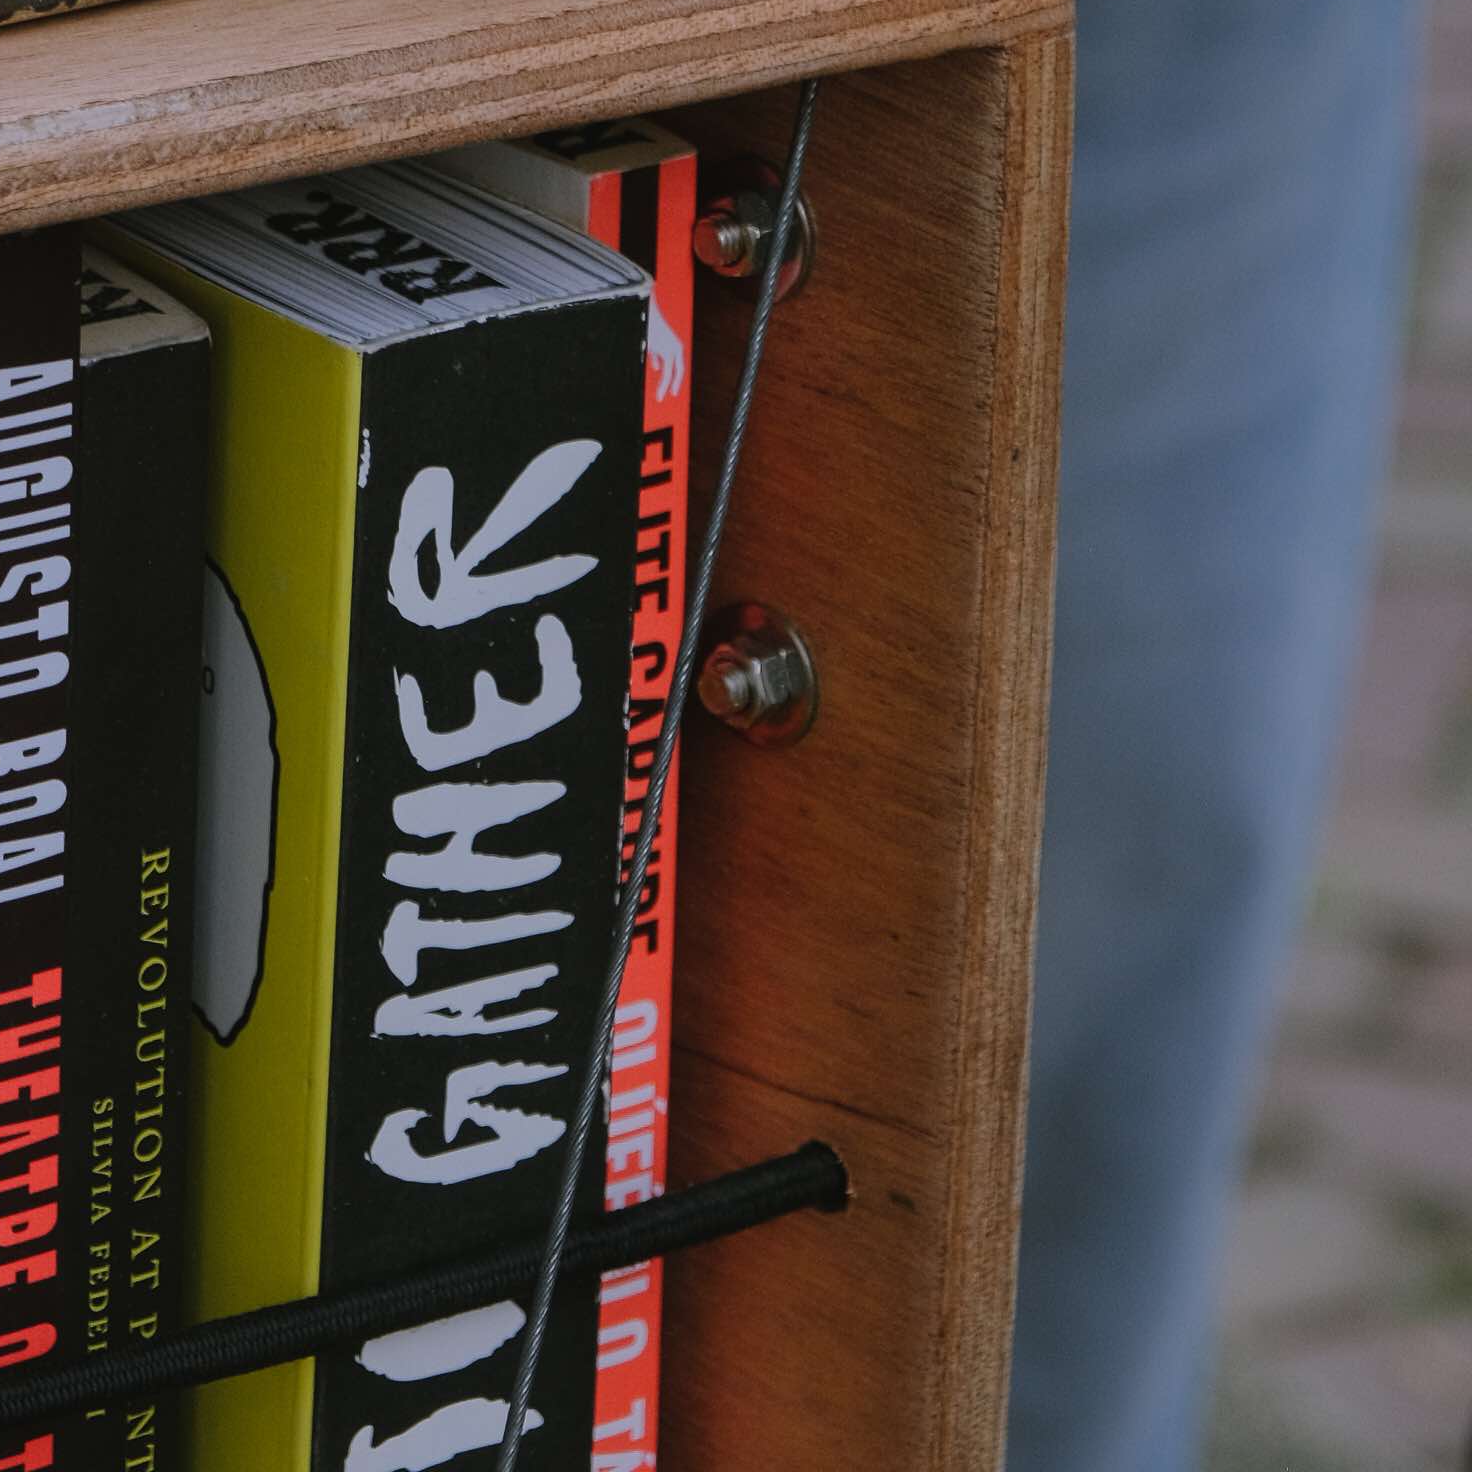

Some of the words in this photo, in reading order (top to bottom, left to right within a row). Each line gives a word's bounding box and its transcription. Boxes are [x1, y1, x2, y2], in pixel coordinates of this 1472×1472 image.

[364, 439, 604, 1186] GATHER
[128, 846, 171, 1205] REVOLUTION
[88, 1096, 115, 1225] SILVIA
[129, 1228, 160, 1290] AT
